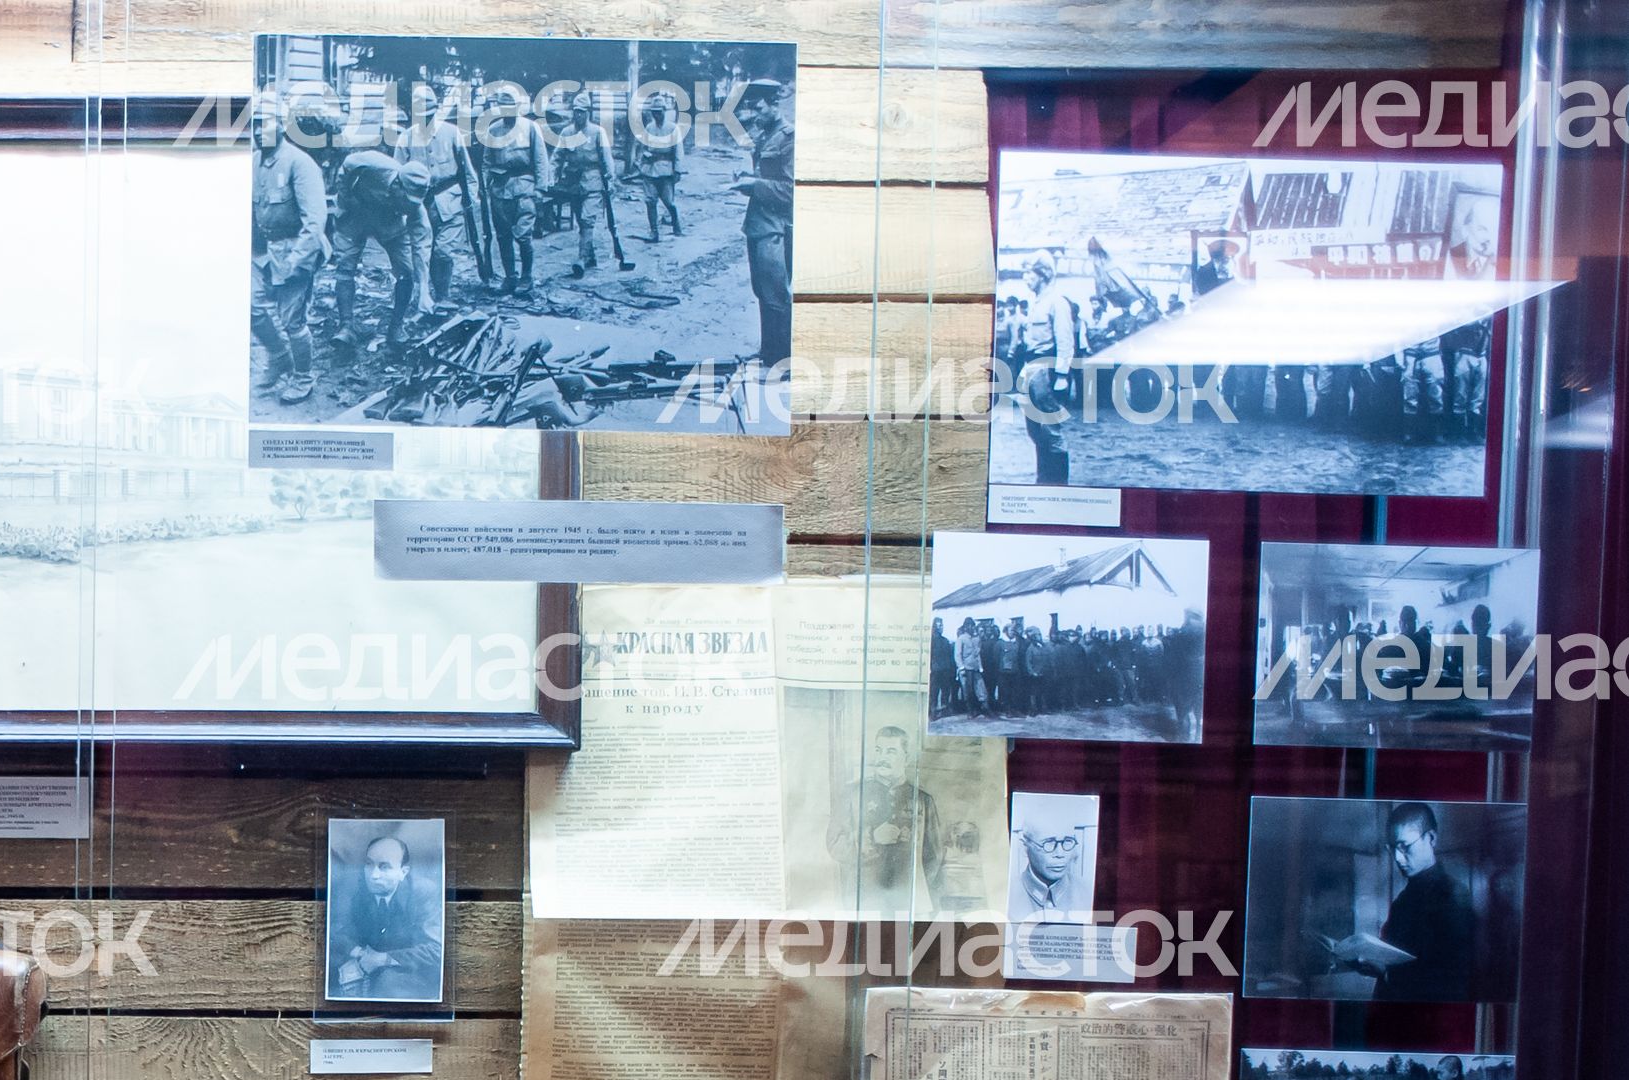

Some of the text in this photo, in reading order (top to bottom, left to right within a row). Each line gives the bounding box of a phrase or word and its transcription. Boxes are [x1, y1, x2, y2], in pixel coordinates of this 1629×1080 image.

[564, 526, 581, 534] 1945
[457, 535, 482, 543] СССР
[616, 631, 769, 655] КРАСНАЯ ЗВЕЗДА
[642, 704, 704, 716] народу
